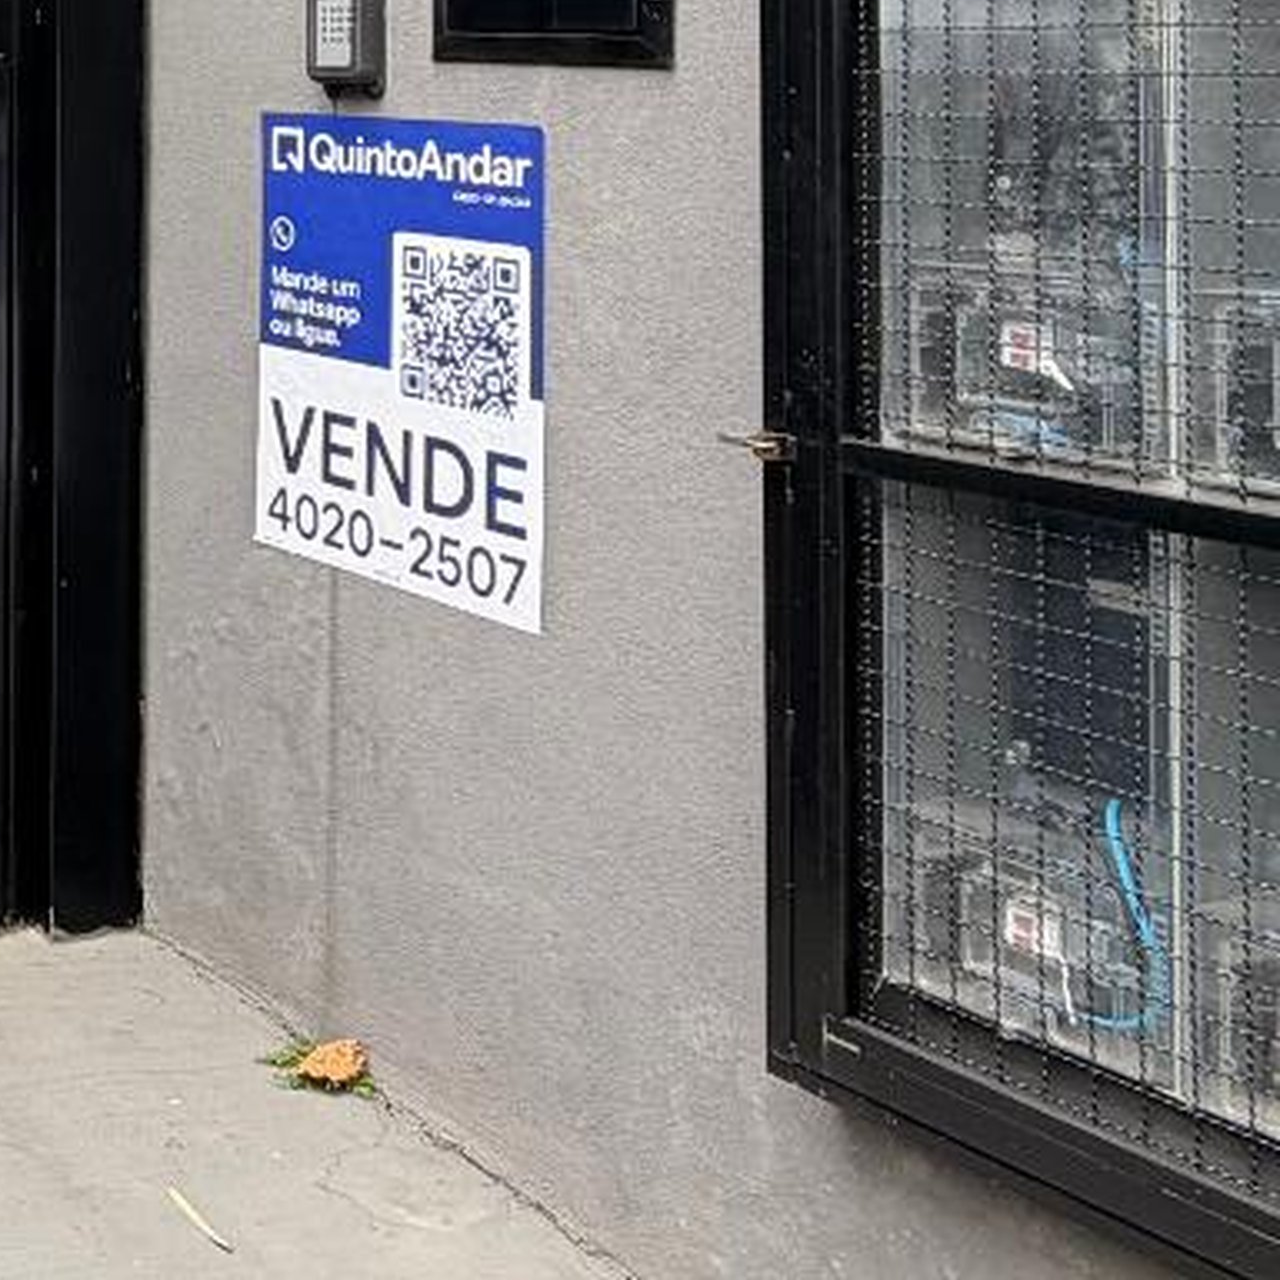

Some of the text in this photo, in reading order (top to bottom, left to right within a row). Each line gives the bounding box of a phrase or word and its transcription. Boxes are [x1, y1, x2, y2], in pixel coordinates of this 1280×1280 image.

[309, 132, 532, 187] QuintoAndar
[271, 265, 361, 300] Mande um
[269, 318, 292, 337] ou
[271, 397, 527, 541] VENDE
[269, 487, 527, 605] 4020-2507
